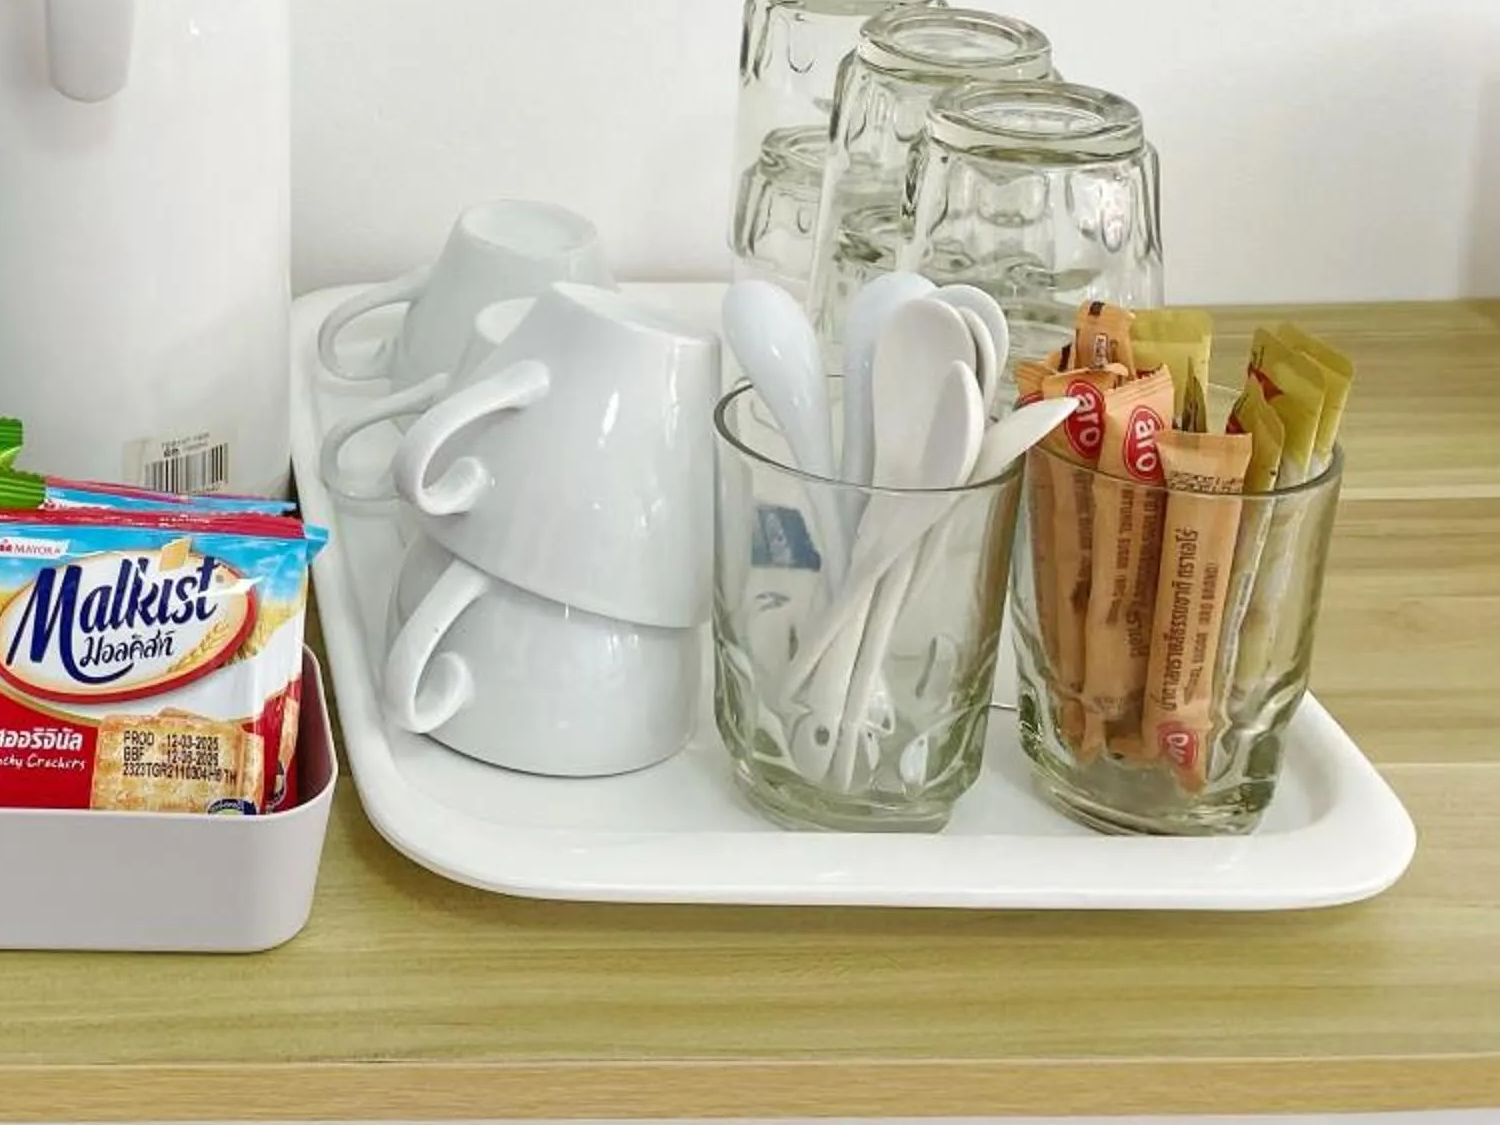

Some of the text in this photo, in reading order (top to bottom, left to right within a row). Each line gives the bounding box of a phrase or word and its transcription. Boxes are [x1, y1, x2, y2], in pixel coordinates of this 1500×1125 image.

[1075, 393, 1101, 447] aro
[1134, 417, 1157, 473] aro
[14, 543, 61, 556] MAYORA
[5, 555, 219, 685] Malkist
[123, 731, 155, 746] PROD
